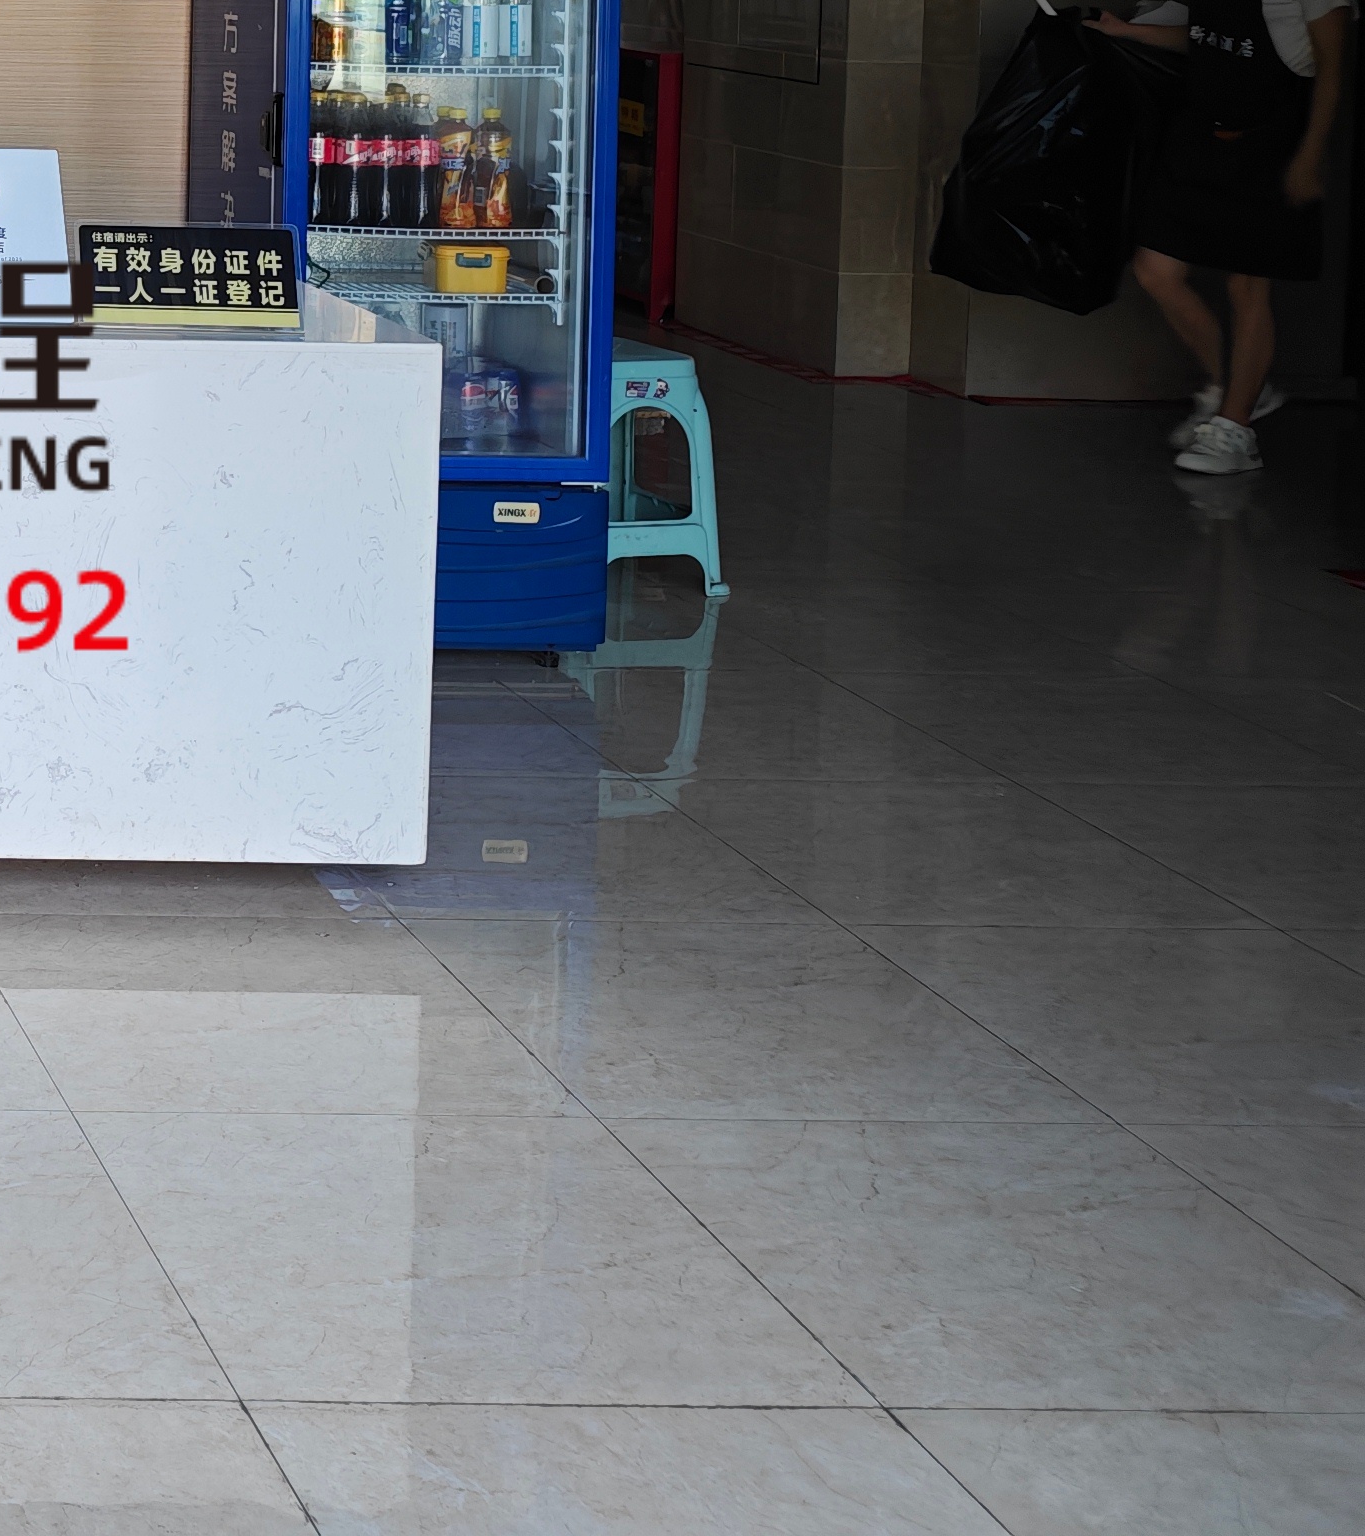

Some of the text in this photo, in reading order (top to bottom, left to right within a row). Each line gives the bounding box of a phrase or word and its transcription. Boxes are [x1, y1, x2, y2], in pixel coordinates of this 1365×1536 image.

[93, 246, 283, 276] 有效身份证件
[95, 277, 285, 306] 一人一证登记
